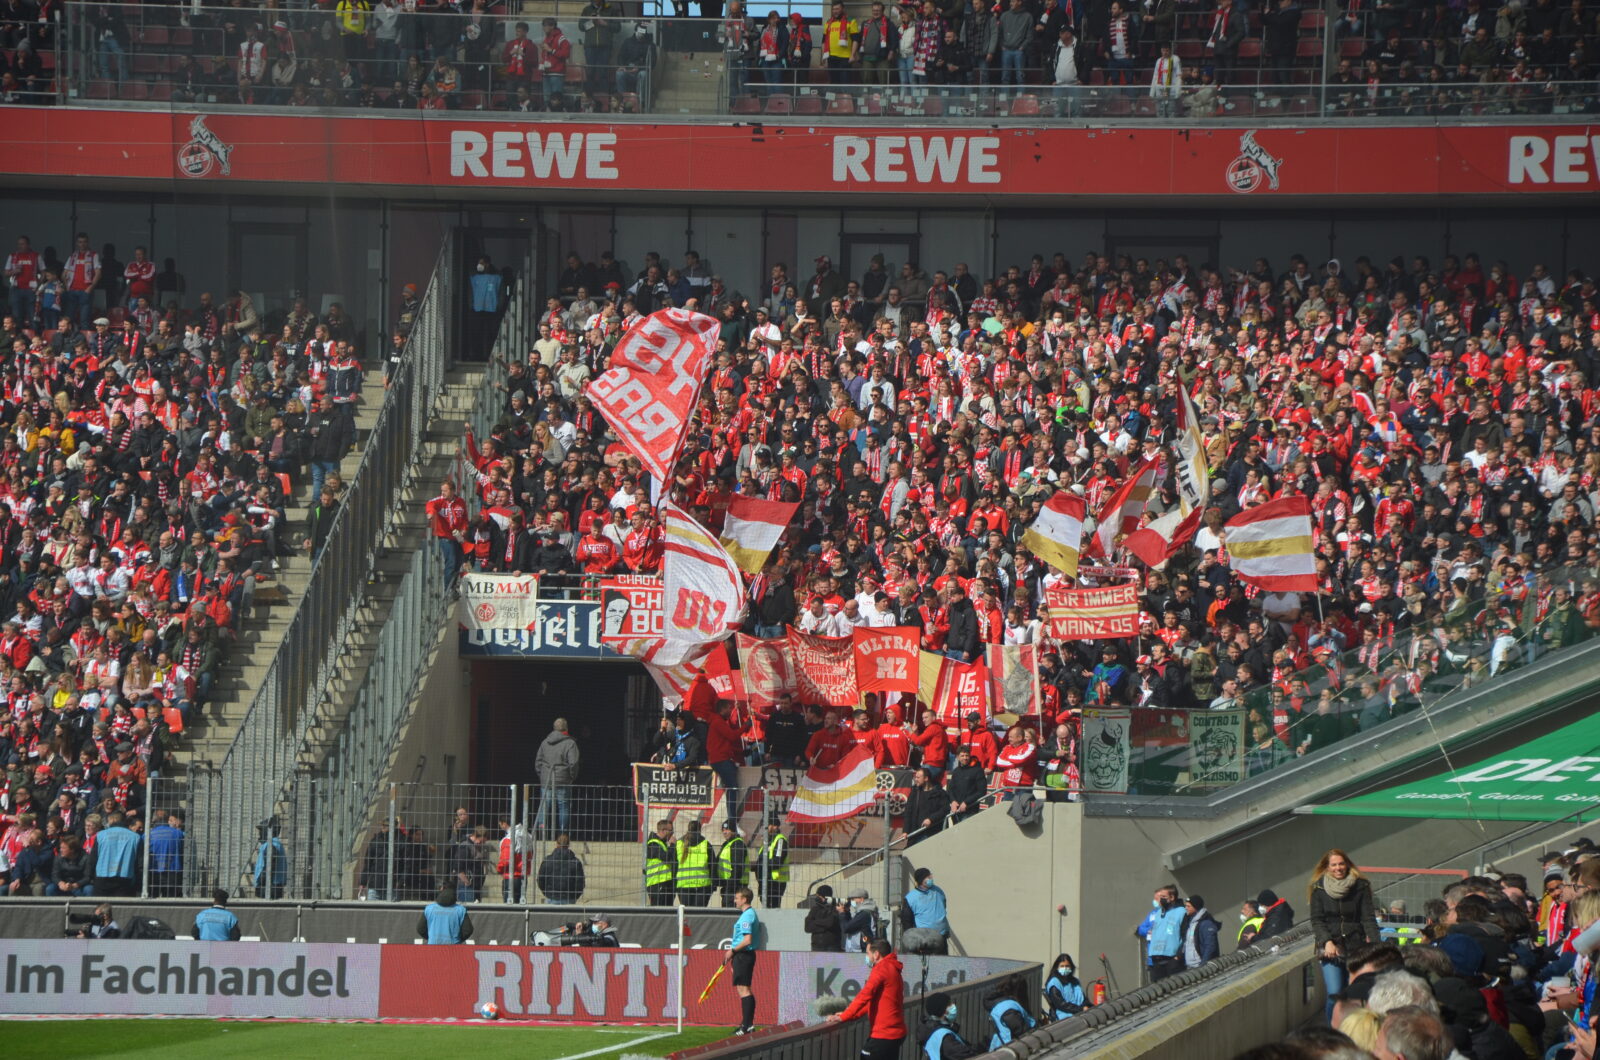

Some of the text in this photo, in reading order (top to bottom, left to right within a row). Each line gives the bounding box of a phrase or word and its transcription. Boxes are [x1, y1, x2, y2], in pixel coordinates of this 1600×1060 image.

[451, 130, 619, 179] REWE
[833, 135, 1001, 183] REWE
[1508, 134, 1600, 183] RE
[465, 581, 532, 594] MBMM
[1045, 586, 1136, 607] FÜR IMMER
[1055, 617, 1134, 635] MAINZ 05
[857, 635, 919, 658] ULTRAS
[876, 656, 908, 680] MZ
[957, 671, 980, 694] 16.
[1193, 715, 1240, 726] CONTRO IL
[652, 770, 696, 783] CURVA
[5, 952, 350, 998] Im Fachhandel
[473, 950, 689, 1018] RINTI
